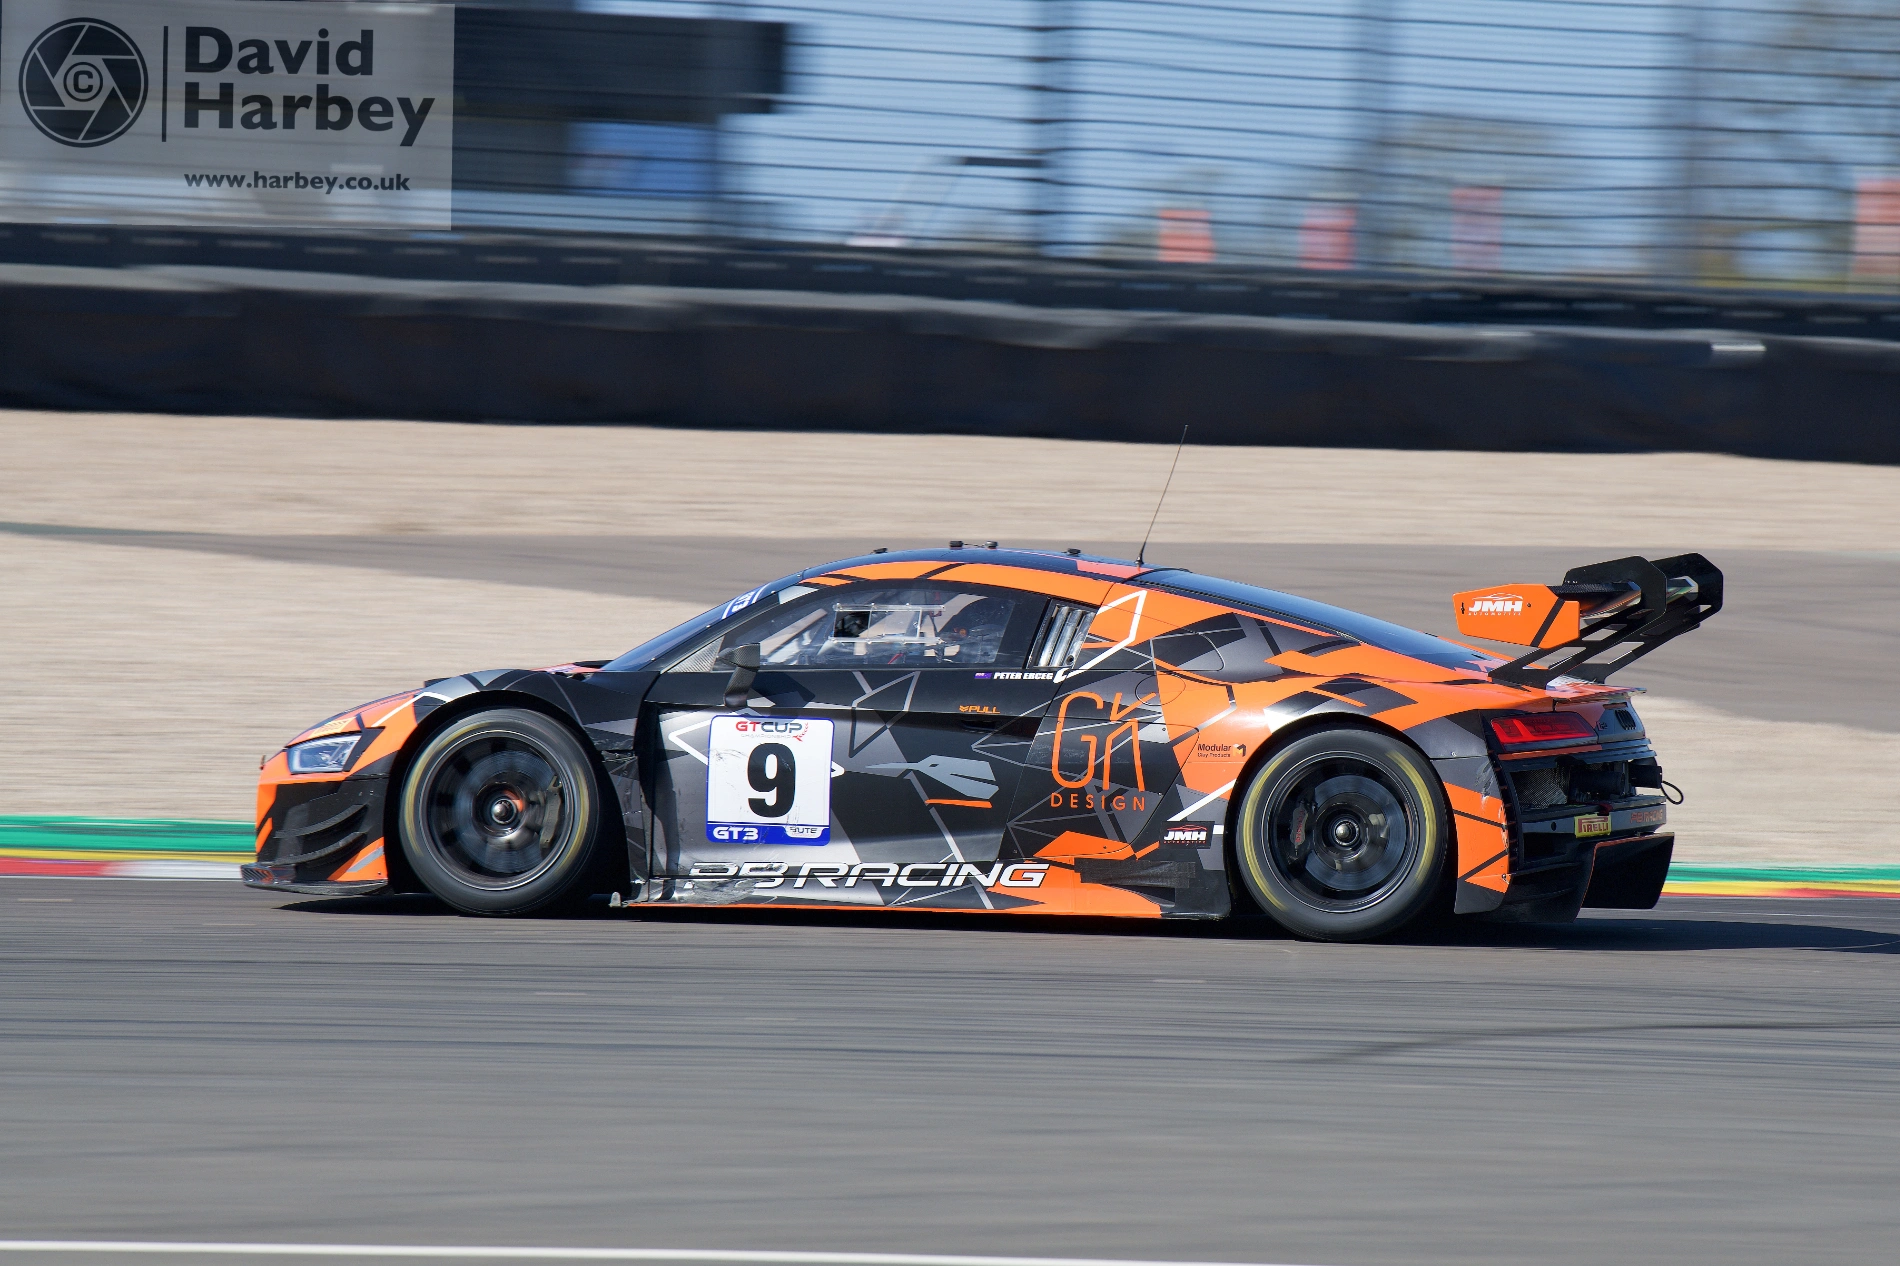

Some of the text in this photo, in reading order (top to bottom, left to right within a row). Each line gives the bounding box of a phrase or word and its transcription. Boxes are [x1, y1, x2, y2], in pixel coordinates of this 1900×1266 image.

[1468, 600, 1523, 612] JMH
[993, 672, 1054, 680] PETER ERCEG
[968, 705, 1001, 714] PULL
[1051, 691, 1157, 792] GK
[1197, 743, 1232, 752] Modular
[747, 742, 796, 818] 9
[1051, 792, 1145, 812] DESIGN
[1578, 816, 1609, 833] PIRELLI
[712, 826, 759, 840] GT3
[1163, 830, 1207, 841] JMH
[793, 862, 1051, 889] RACING
